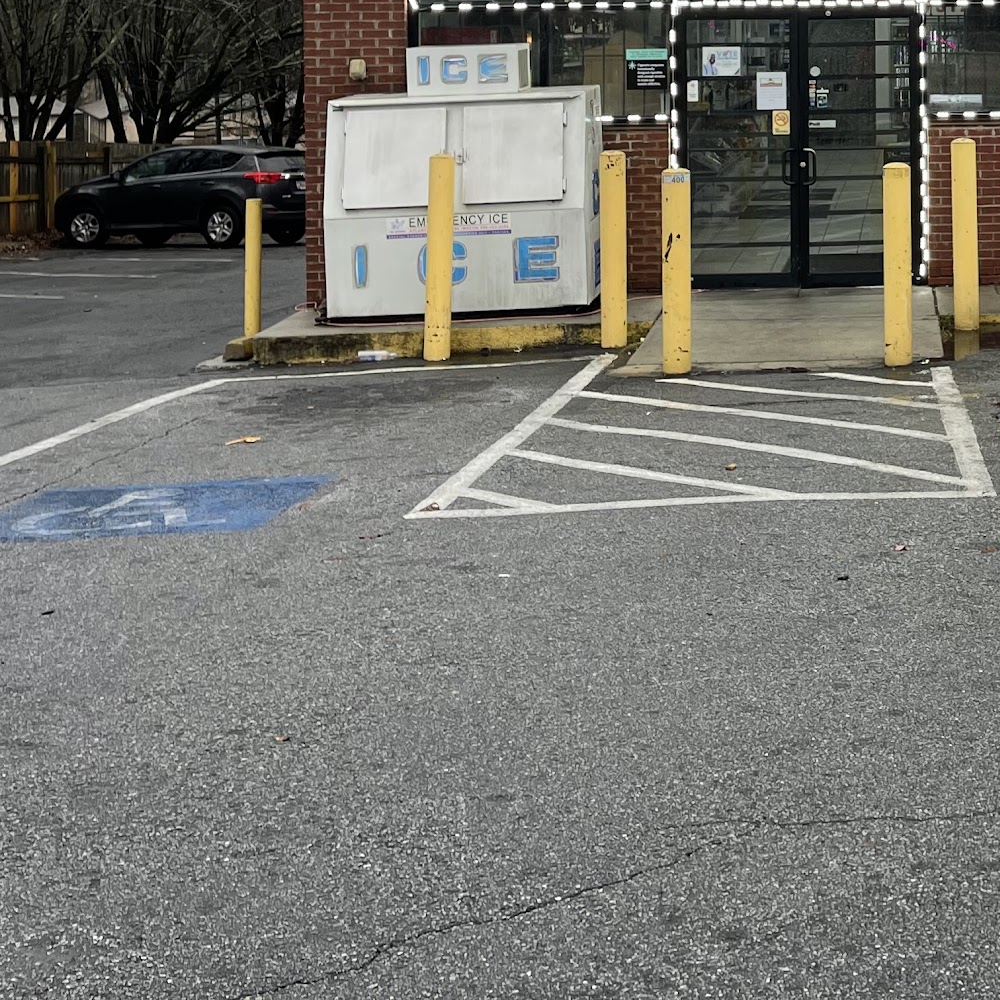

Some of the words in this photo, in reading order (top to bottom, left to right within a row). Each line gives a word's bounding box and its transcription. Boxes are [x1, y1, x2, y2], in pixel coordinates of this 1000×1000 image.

[417, 54, 509, 86] ICE
[408, 214, 484, 228] EMENCY
[490, 213, 509, 225] ICE
[353, 236, 560, 289] ICE
